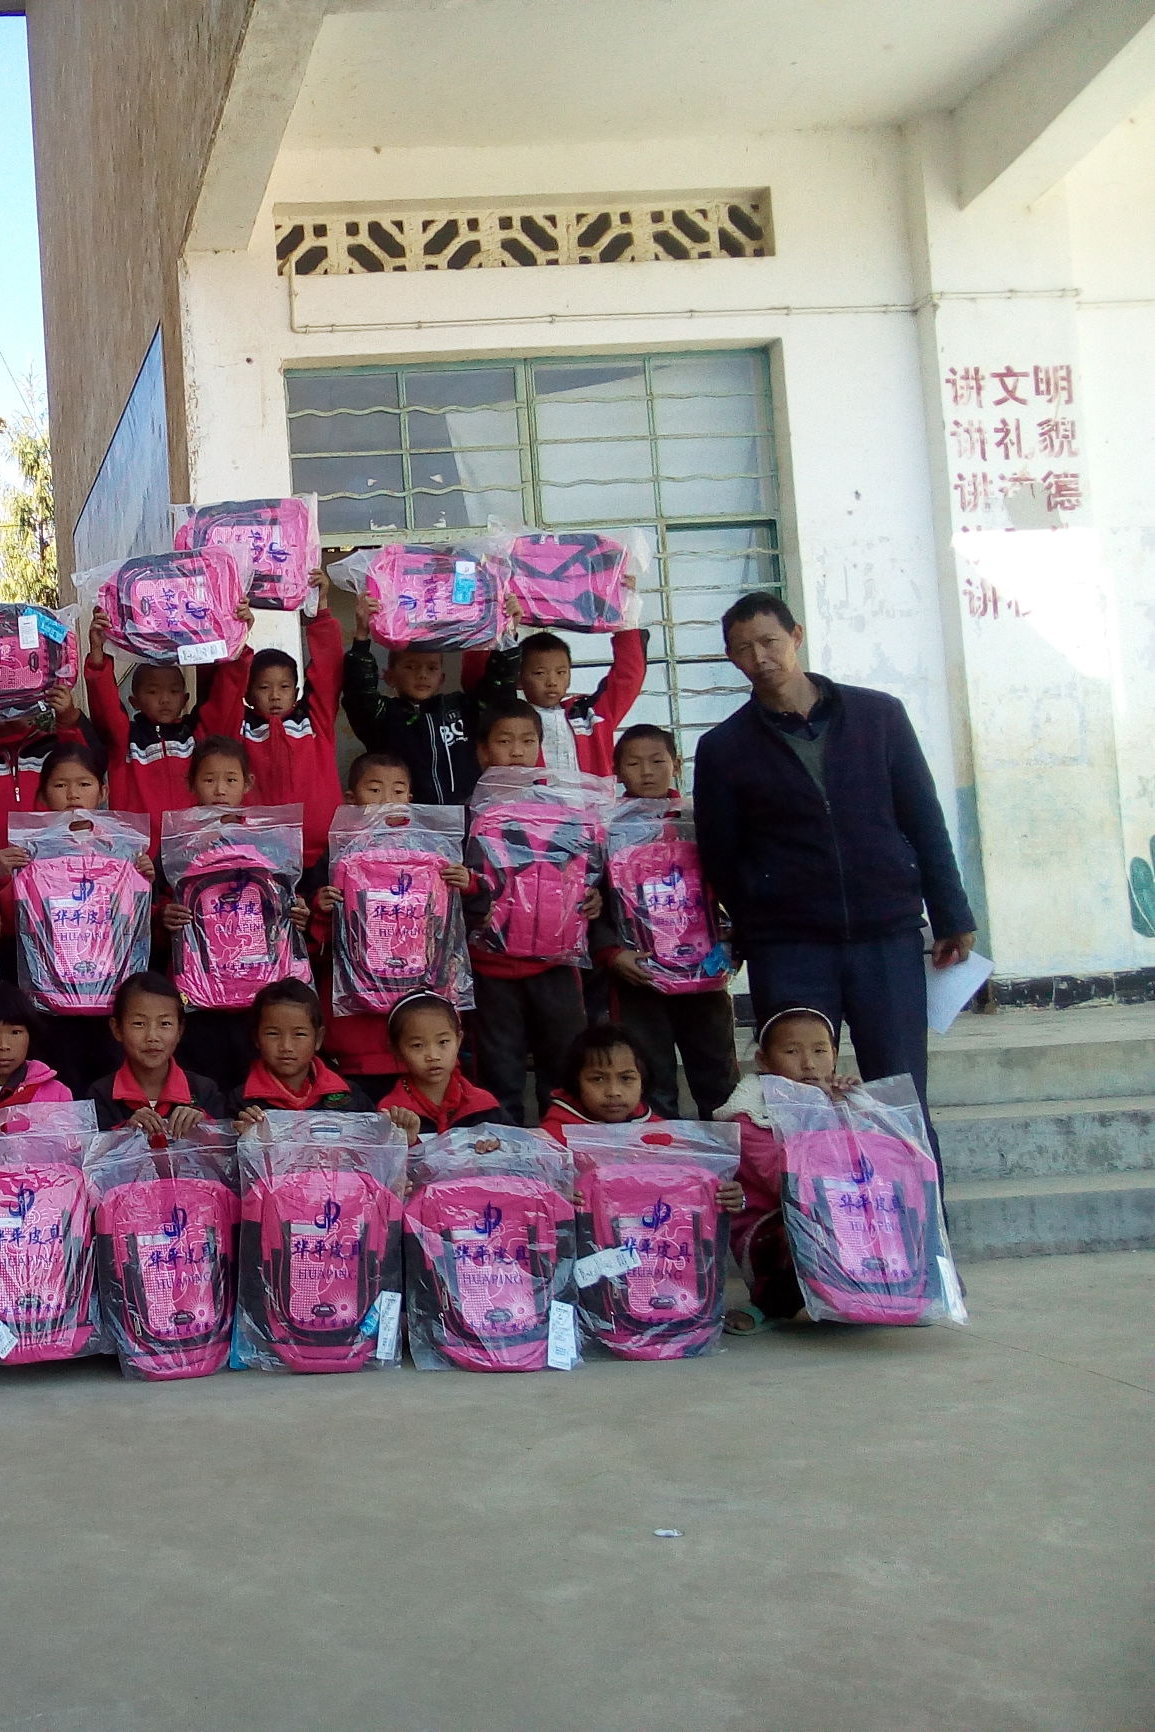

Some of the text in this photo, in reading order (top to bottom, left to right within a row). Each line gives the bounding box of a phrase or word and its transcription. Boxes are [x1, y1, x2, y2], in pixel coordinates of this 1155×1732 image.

[945, 364, 1075, 408] 讲文明
[950, 416, 1080, 461] 讲礼貌
[620, 1236, 691, 1263] 华平皮具
[462, 1272, 524, 1286] HUAPING
